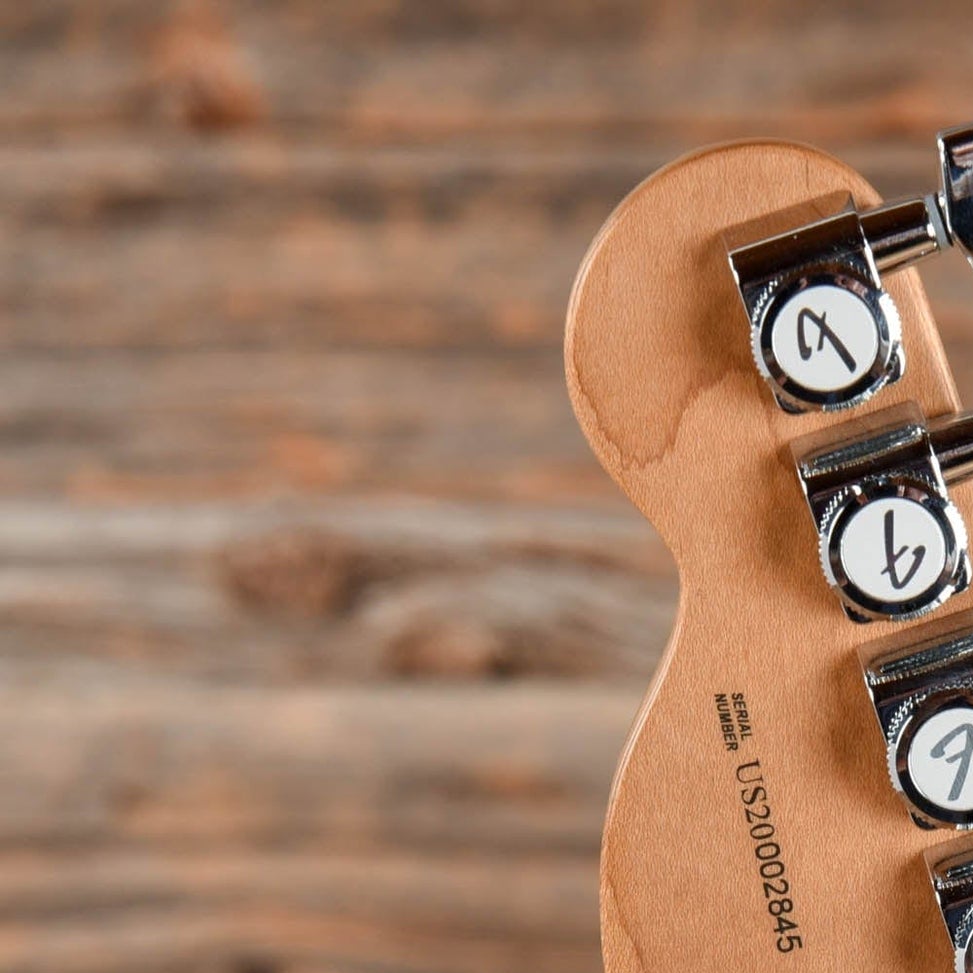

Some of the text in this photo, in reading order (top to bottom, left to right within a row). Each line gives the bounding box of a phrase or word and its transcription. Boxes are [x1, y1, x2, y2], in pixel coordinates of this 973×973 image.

[714, 693, 739, 752] NUMBER
[731, 692, 753, 741] SERIAL
[736, 757, 803, 954] US20002845
